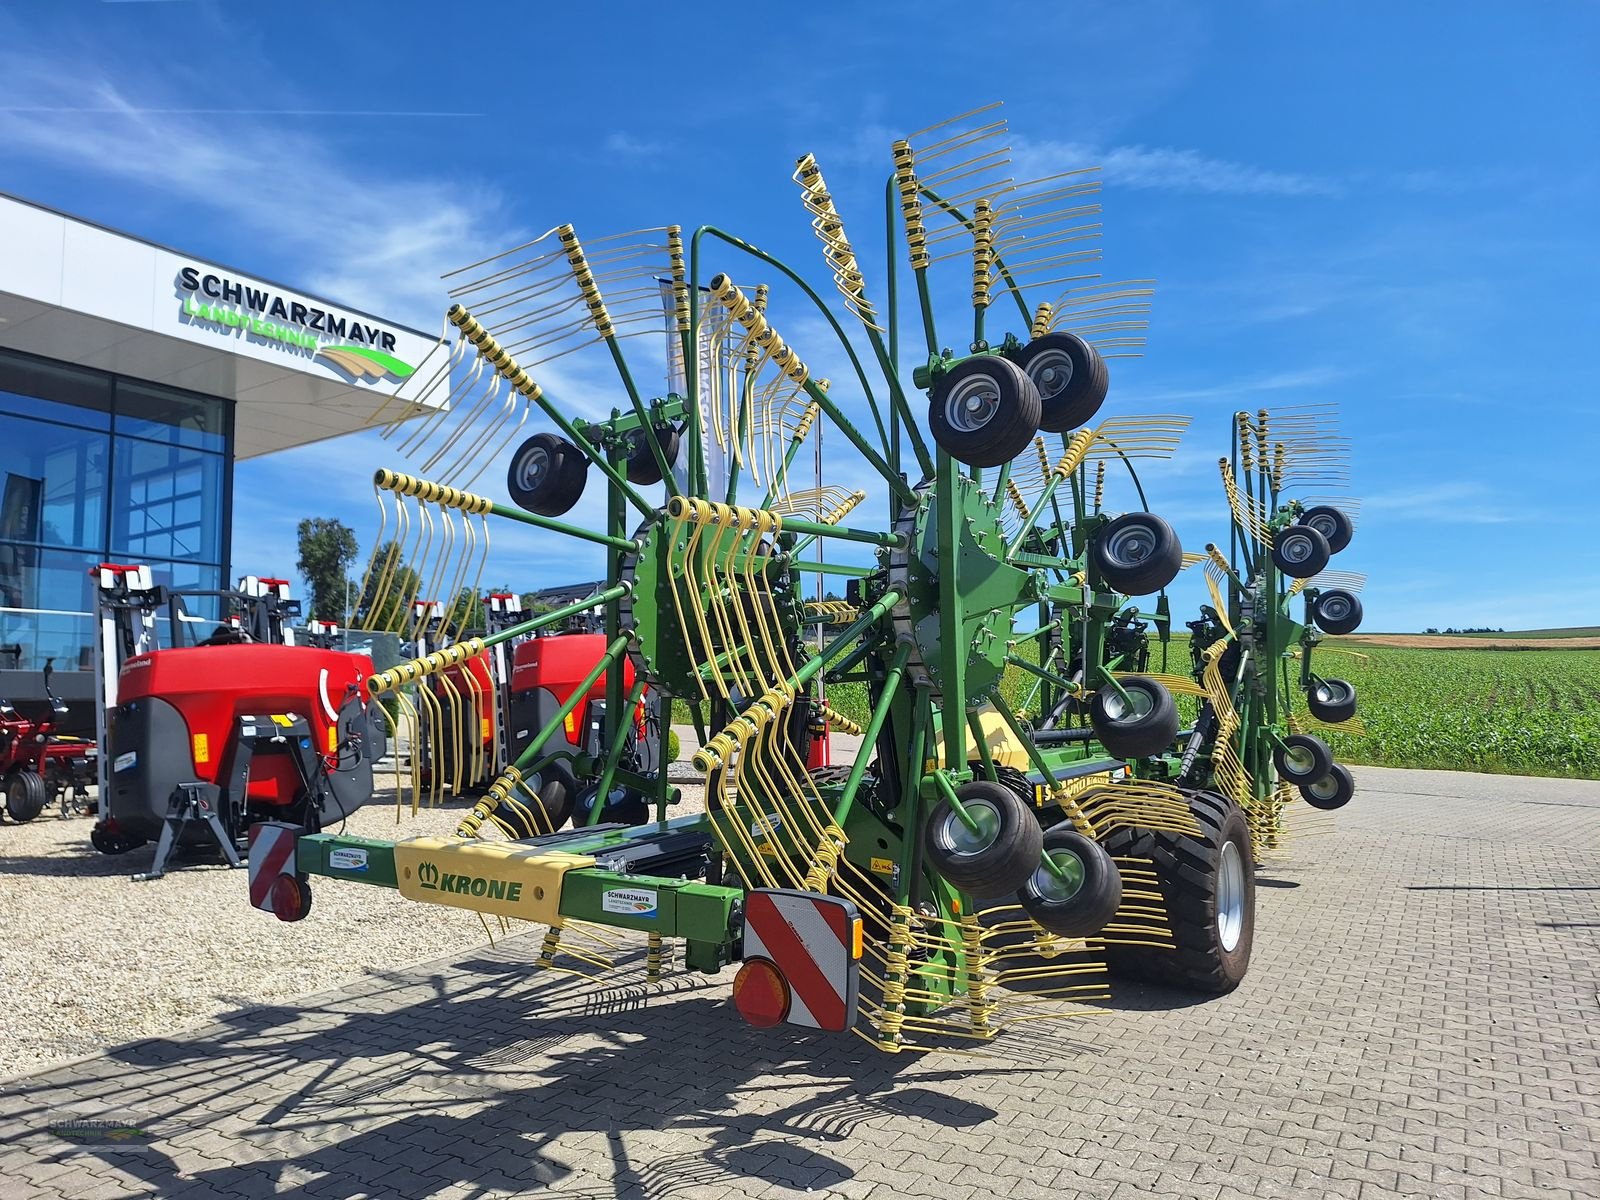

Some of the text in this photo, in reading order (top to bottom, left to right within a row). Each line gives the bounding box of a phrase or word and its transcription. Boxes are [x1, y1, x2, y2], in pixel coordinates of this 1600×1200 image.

[179, 267, 397, 352] SCHWARZMAYR
[183, 297, 318, 351] LANDTECHNIK
[440, 873, 523, 901] KRONE
[607, 891, 650, 902] SCHWARZMAYR
